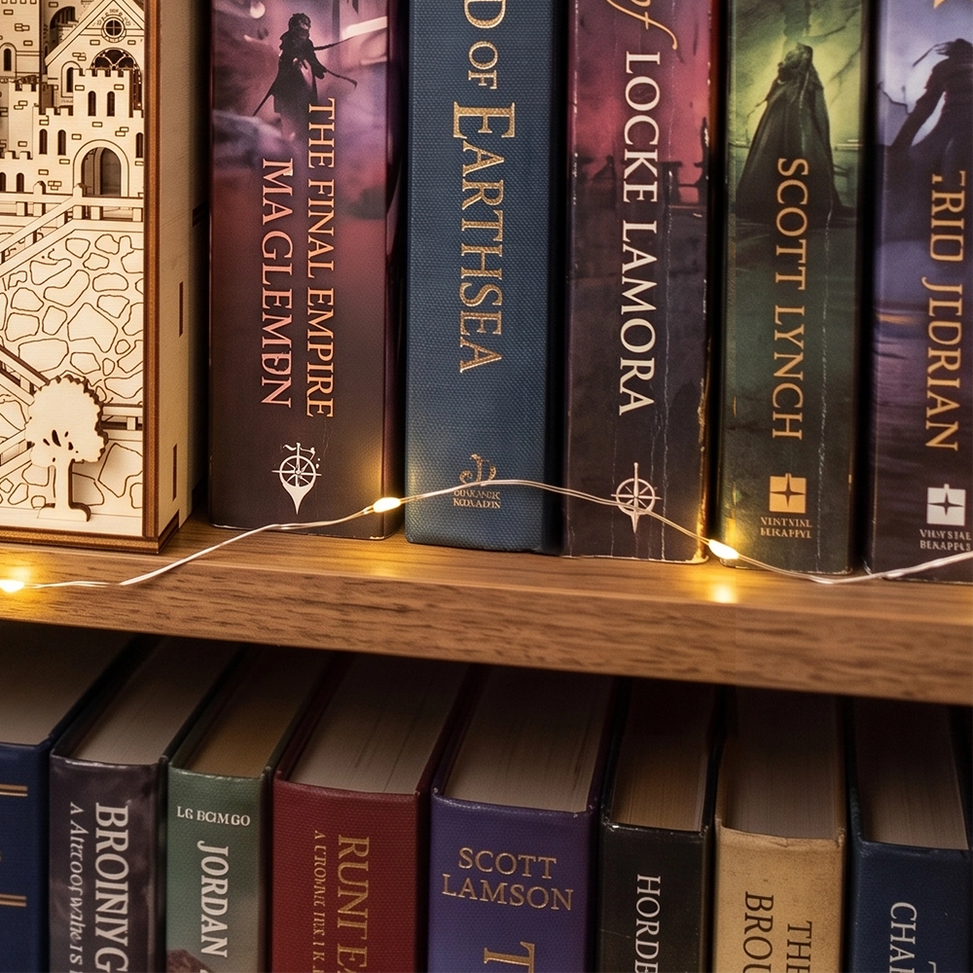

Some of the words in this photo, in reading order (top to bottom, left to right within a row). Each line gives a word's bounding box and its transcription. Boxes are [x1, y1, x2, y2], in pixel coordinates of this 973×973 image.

[468, 40, 499, 89] OF
[623, 51, 660, 202] LOCKE
[308, 98, 336, 169] THE
[307, 179, 336, 278] FINAL
[453, 101, 515, 374] EARTHSEA
[775, 157, 810, 291] SCOTT
[305, 287, 336, 418] EMPIRE
[618, 221, 658, 416] LAMORA
[772, 306, 806, 440] LYNCH
[196, 840, 230, 958] JORDAN
[441, 872, 574, 912] LAMSON
[458, 846, 558, 880] SCOTT
